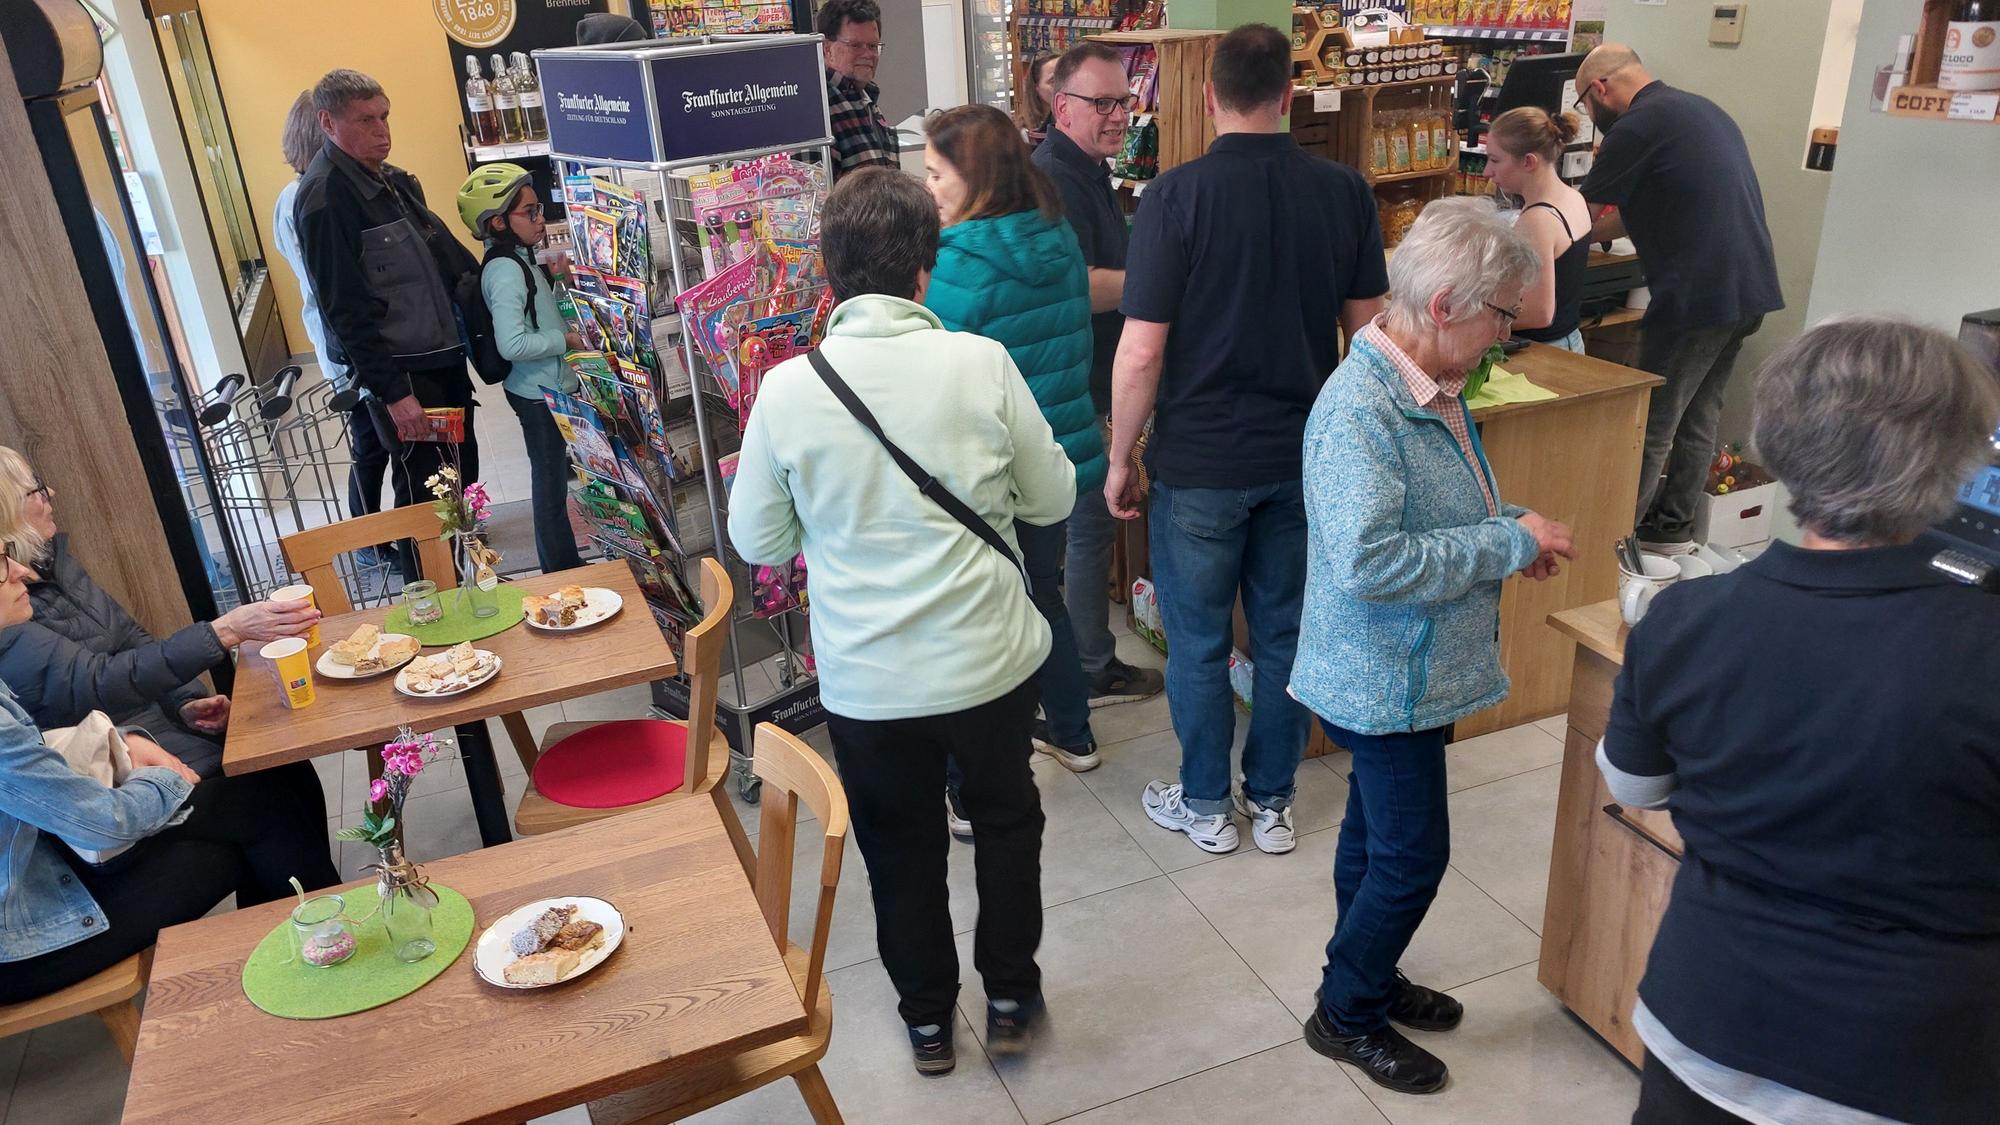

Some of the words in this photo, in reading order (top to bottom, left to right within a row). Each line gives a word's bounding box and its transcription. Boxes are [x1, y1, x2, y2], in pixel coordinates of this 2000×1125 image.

[460, 3, 495, 23] 1848
[557, 92, 594, 112] Frankfurter
[593, 93, 630, 115] Allgemeine
[682, 90, 744, 113] Frankfurter
[744, 81, 799, 105] Allgemeine
[1896, 94, 1947, 112] COFI
[594, 115, 627, 124] DEUTSCHLAND
[711, 103, 776, 118] SONNTAGSZEITUNG
